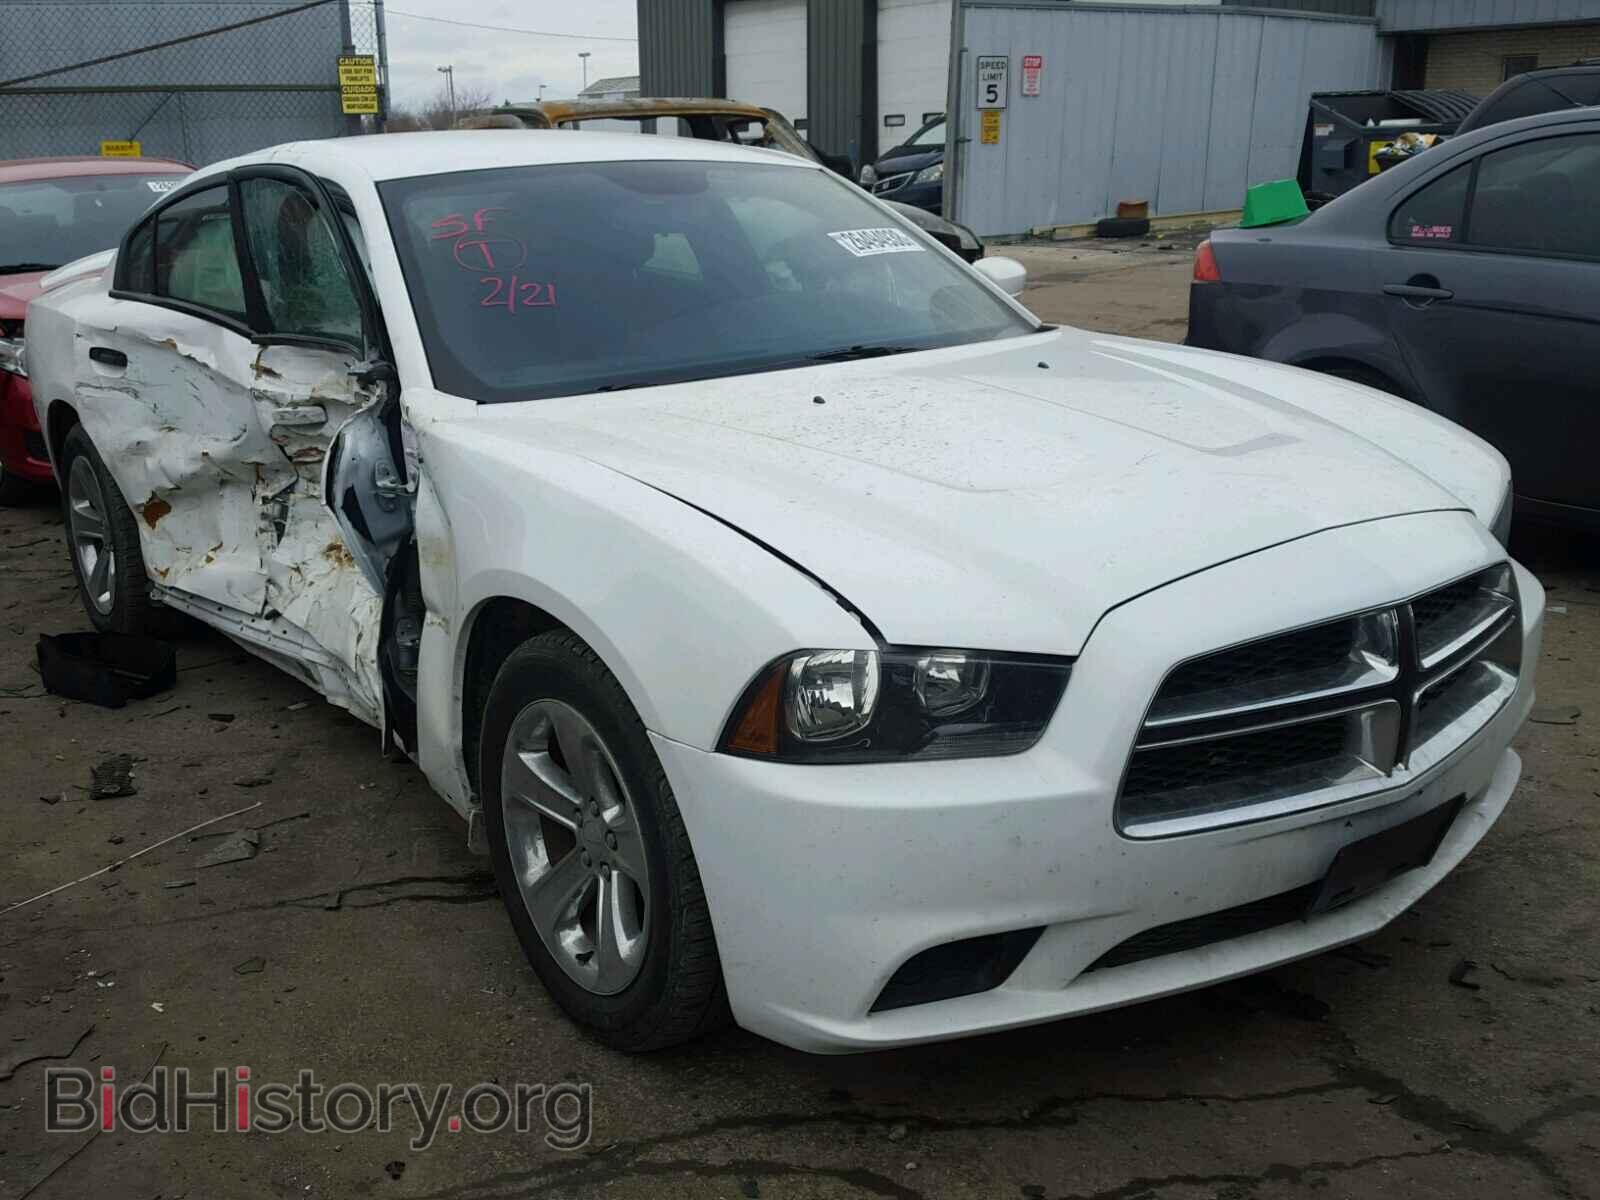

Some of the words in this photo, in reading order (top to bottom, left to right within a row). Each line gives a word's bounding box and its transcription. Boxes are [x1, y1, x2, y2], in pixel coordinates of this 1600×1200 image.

[980, 61, 1006, 70] SPEED
[982, 73, 1003, 81] LIMIT
[986, 84, 998, 103] 5
[479, 274, 558, 315] 2/21
